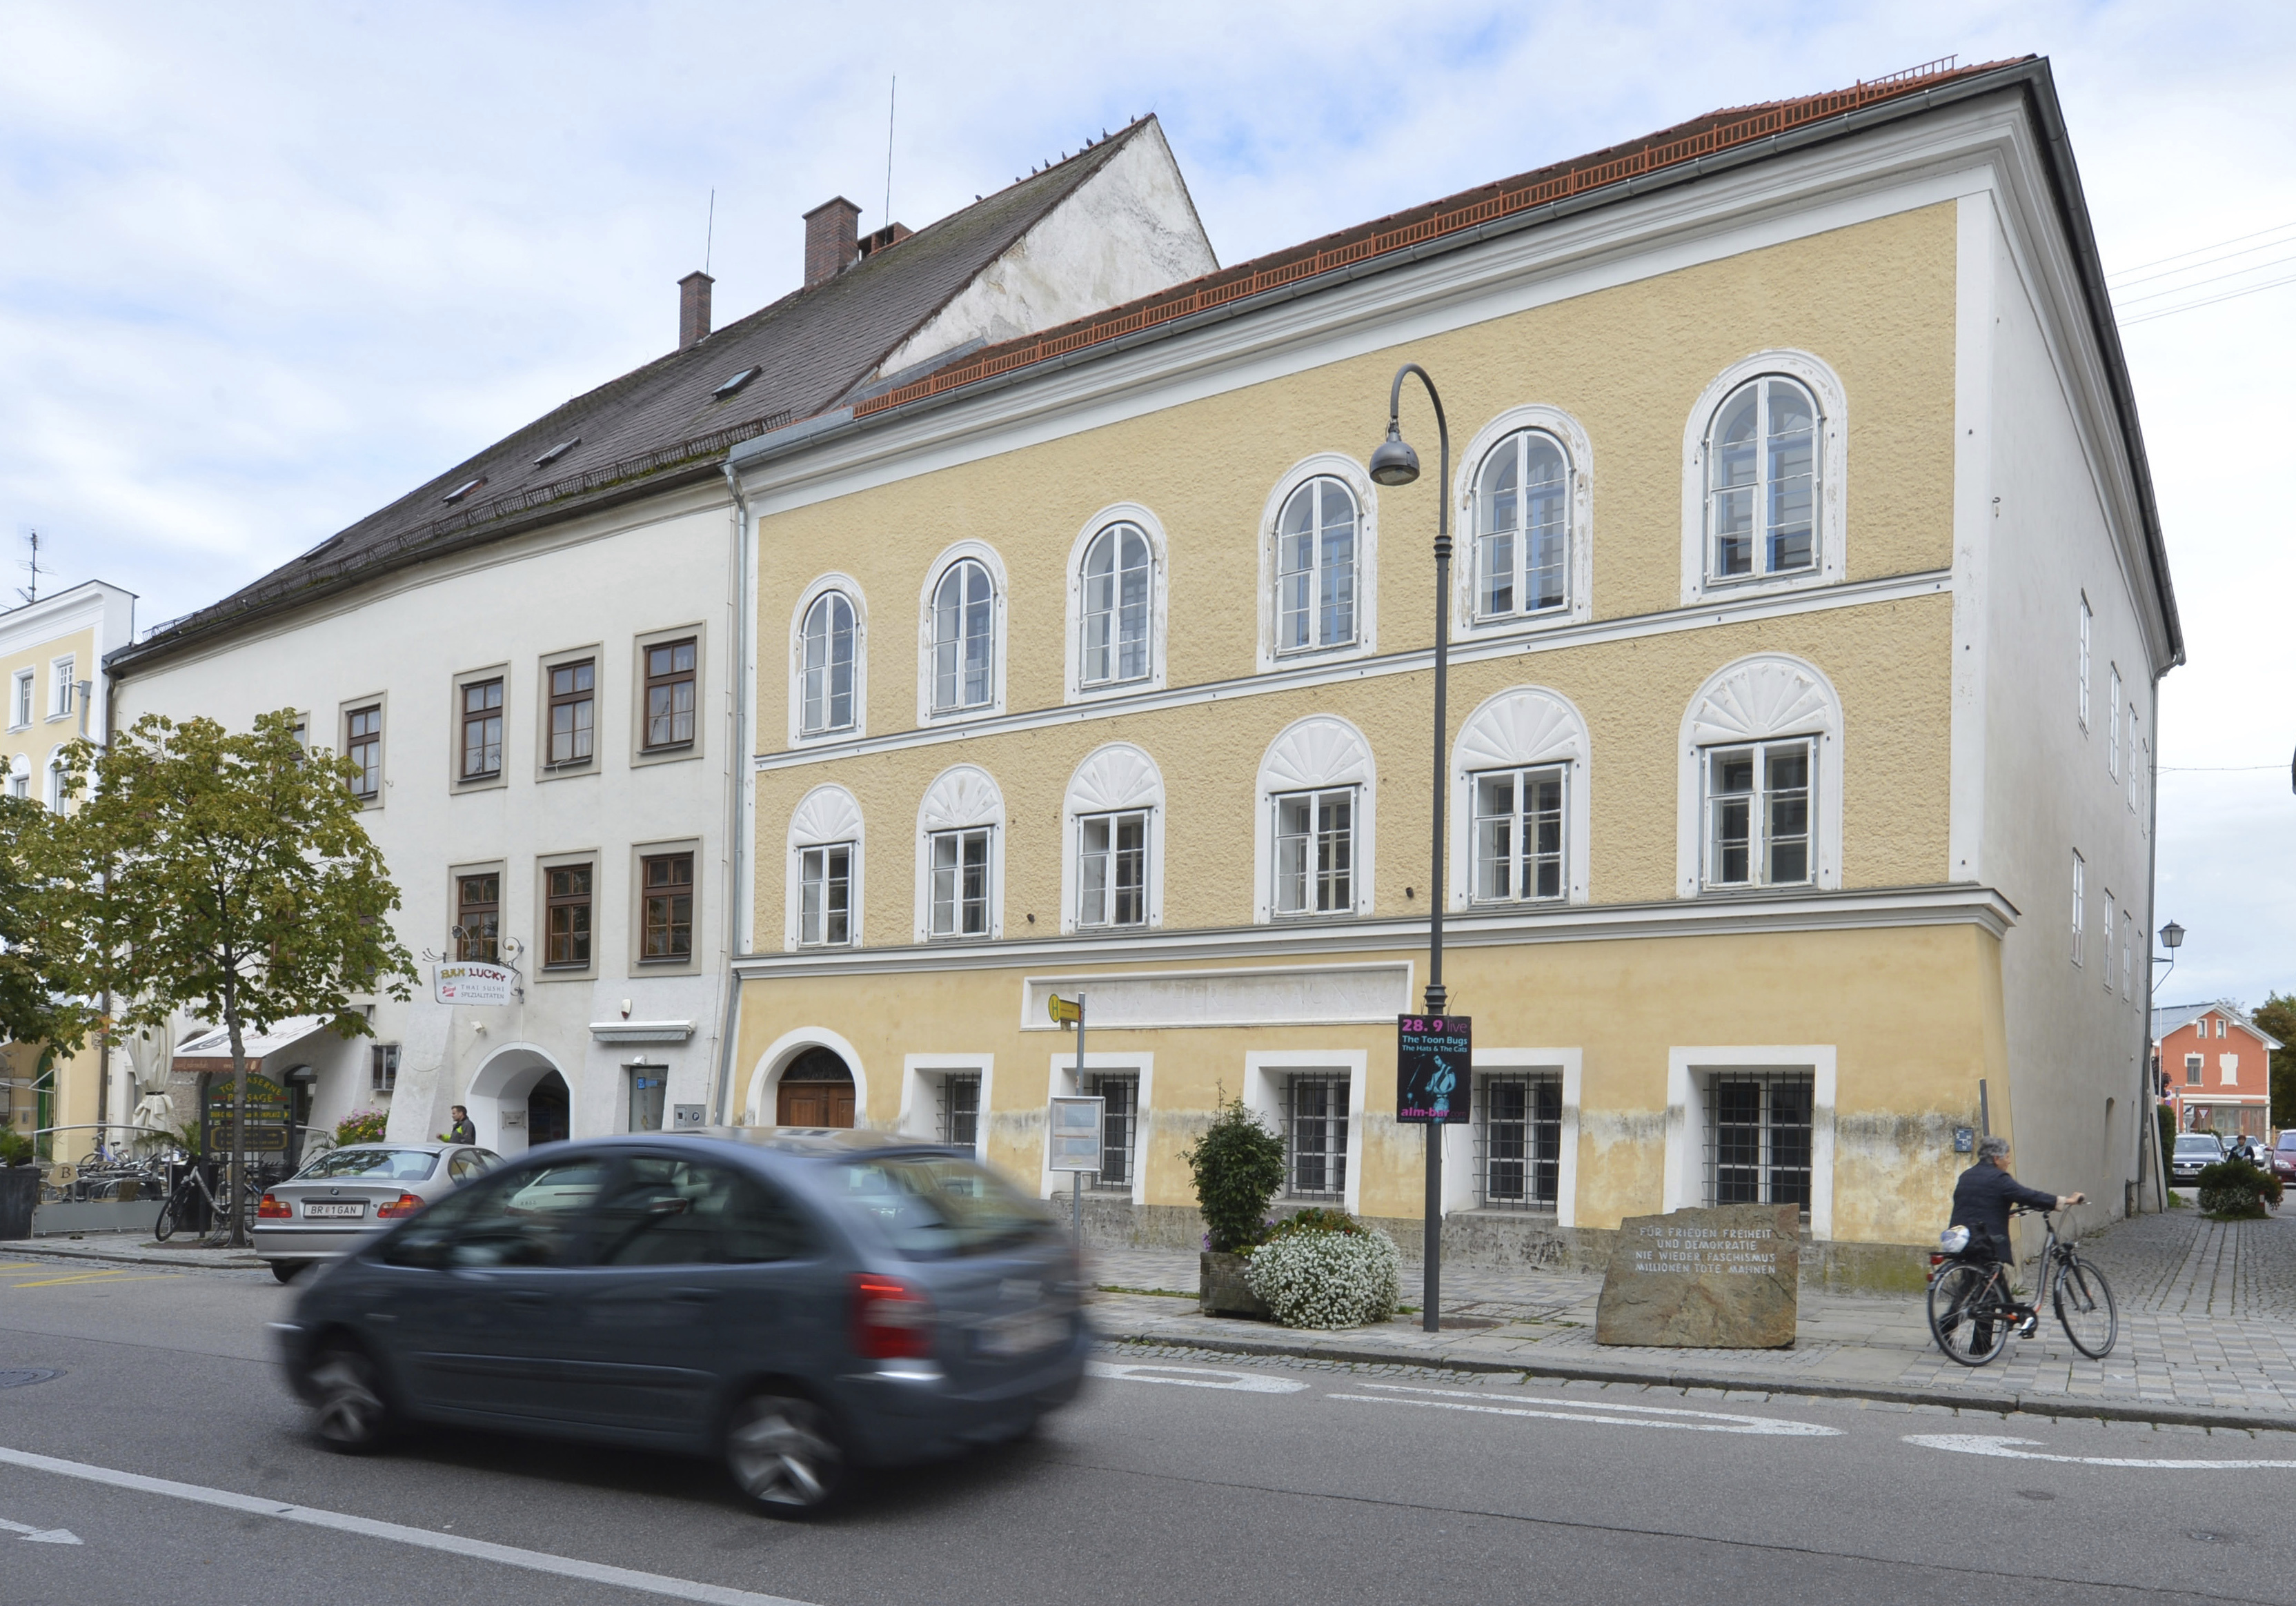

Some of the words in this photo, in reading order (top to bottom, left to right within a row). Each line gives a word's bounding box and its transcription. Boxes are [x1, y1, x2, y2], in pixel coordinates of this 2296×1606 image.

[468, 967, 506, 982] LUCKY
[1052, 1000, 1058, 1017] H
[1402, 1019, 1428, 1032] 28.
[1433, 1019, 1443, 1032] 9
[1447, 1020, 1467, 1033] live
[1402, 1035, 1419, 1044] The
[1421, 1035, 1444, 1044] Toon
[1447, 1036, 1467, 1047] Bugs
[228, 1093, 274, 1102] PSAGE
[61, 1167, 70, 1178] B
[311, 1206, 323, 1214] BR
[332, 1206, 356, 1214] 1GAN
[1640, 1225, 1662, 1237] FÜR
[1669, 1228, 1717, 1238] FRIEDEN
[1723, 1229, 1772, 1239] FREIHEIT
[1657, 1239, 1679, 1249] UND
[1685, 1240, 1757, 1251] DEMOKRATIE
[1636, 1251, 1652, 1260] NIE
[1659, 1251, 1701, 1261] WIEDER
[1708, 1252, 1776, 1262] FASCHISMUS
[1635, 1263, 1690, 1273] MILLIONEN
[1695, 1263, 1721, 1273] TOTE
[1729, 1265, 1776, 1274] MAHNEN
